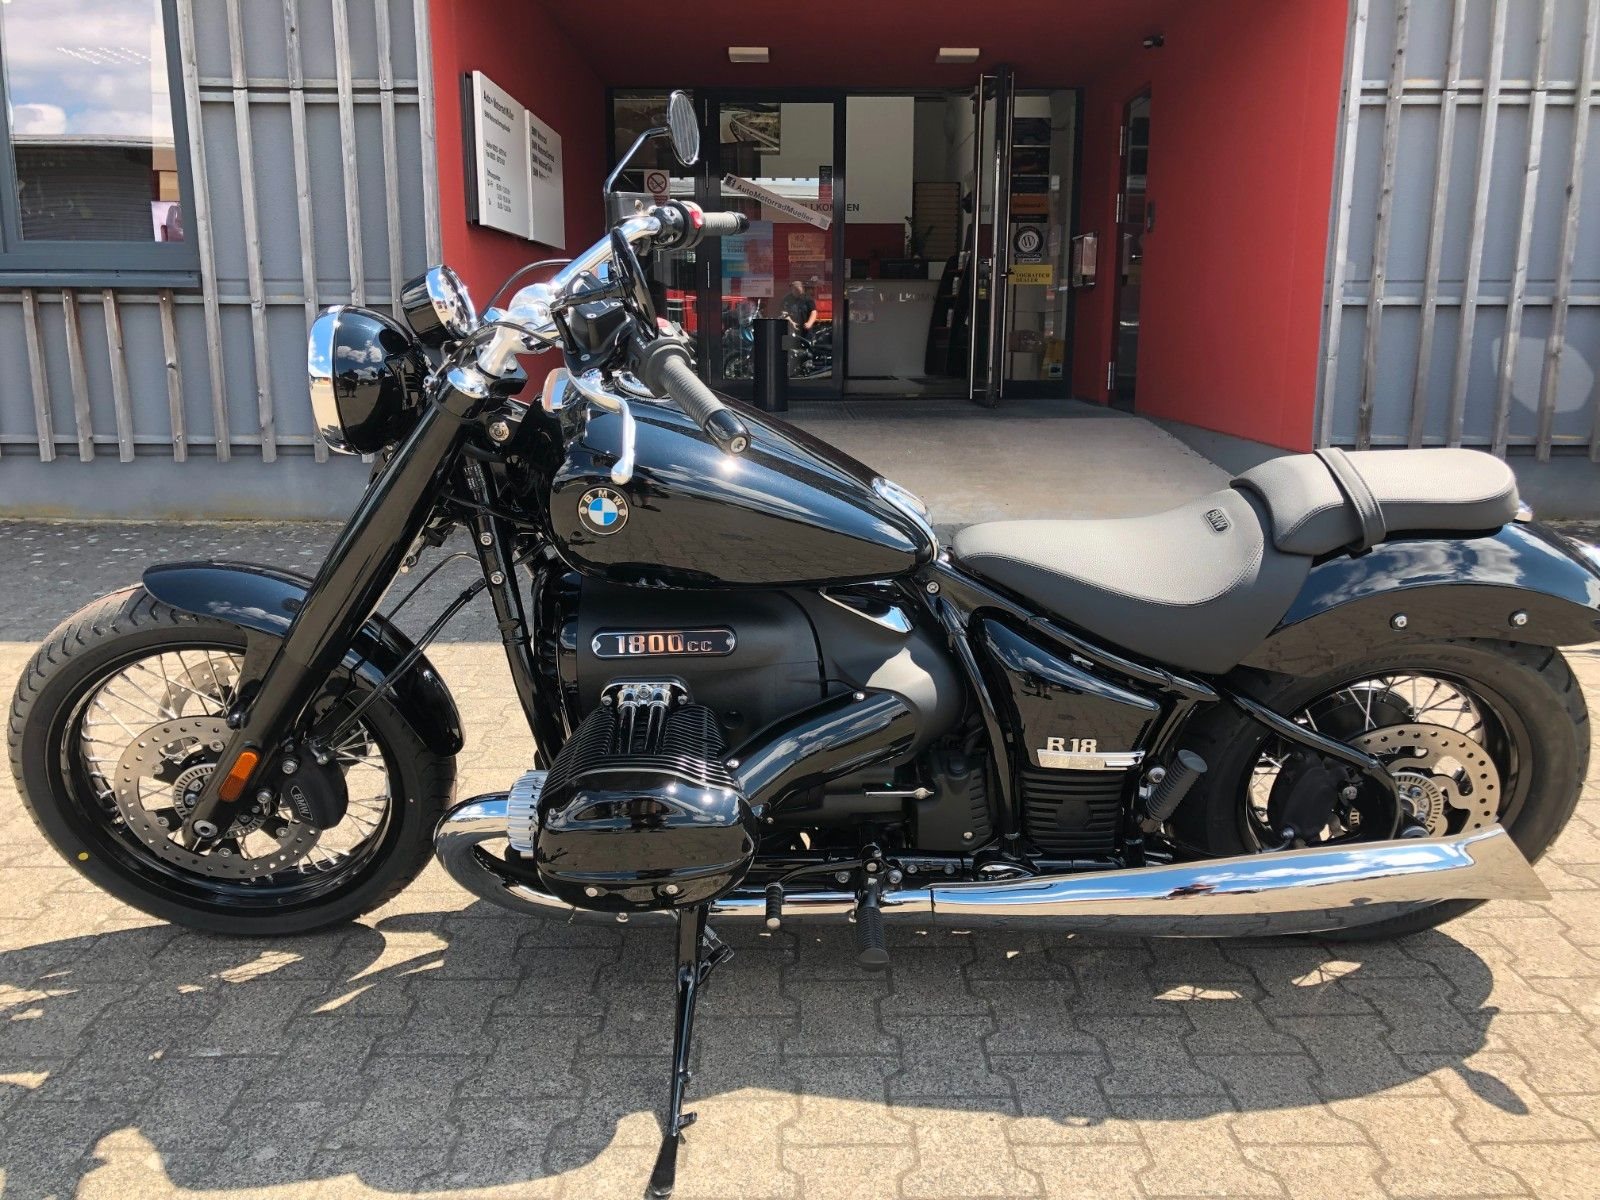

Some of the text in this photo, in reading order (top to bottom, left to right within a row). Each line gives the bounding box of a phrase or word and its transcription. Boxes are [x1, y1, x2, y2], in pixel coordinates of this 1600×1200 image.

[736, 184, 815, 222] AutoMotorradMueller
[584, 489, 622, 505] BMW
[294, 793, 309, 814] BMW
